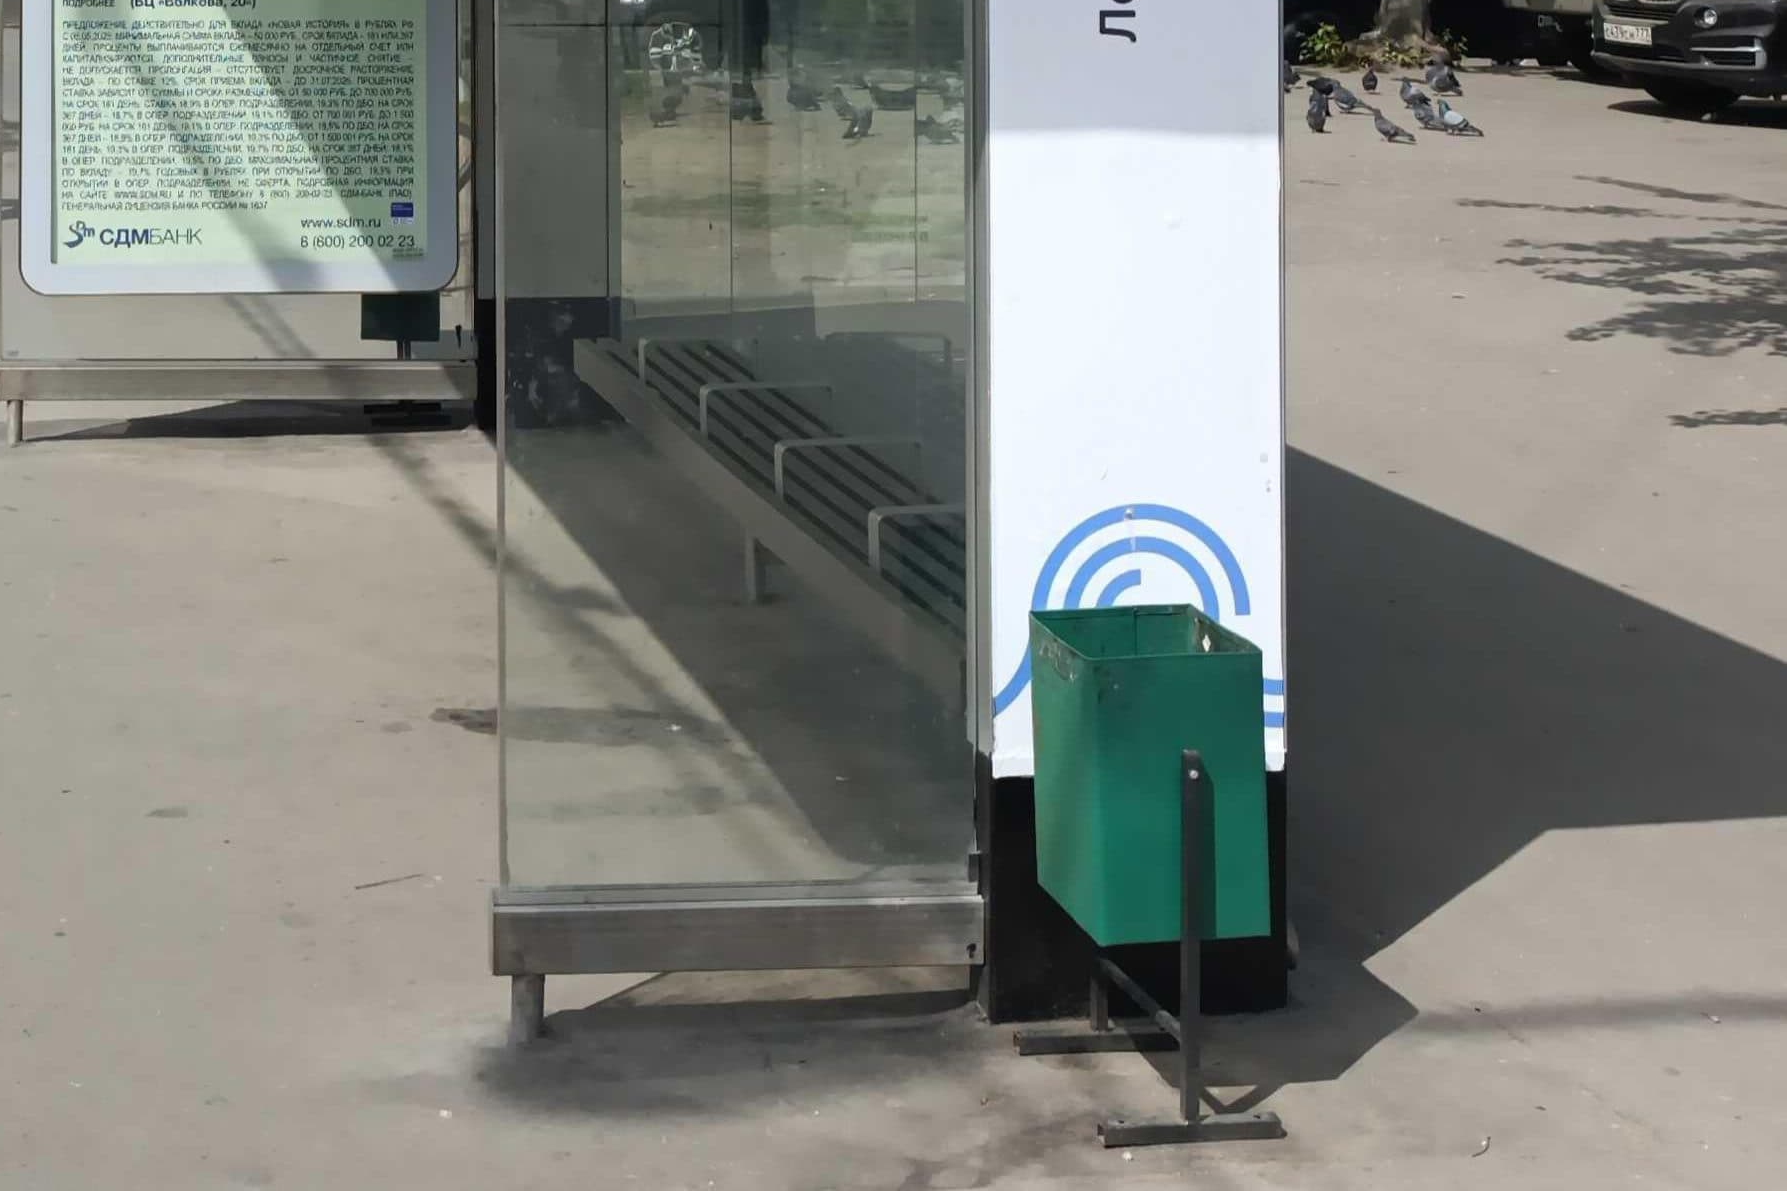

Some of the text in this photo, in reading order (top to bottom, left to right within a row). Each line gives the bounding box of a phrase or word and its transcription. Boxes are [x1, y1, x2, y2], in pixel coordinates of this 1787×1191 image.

[300, 216, 382, 229] www.sdm.ru
[99, 228, 203, 248] СДМБАНК
[349, 235, 374, 248] 200
[377, 235, 394, 248] 02
[398, 235, 416, 248] 23
